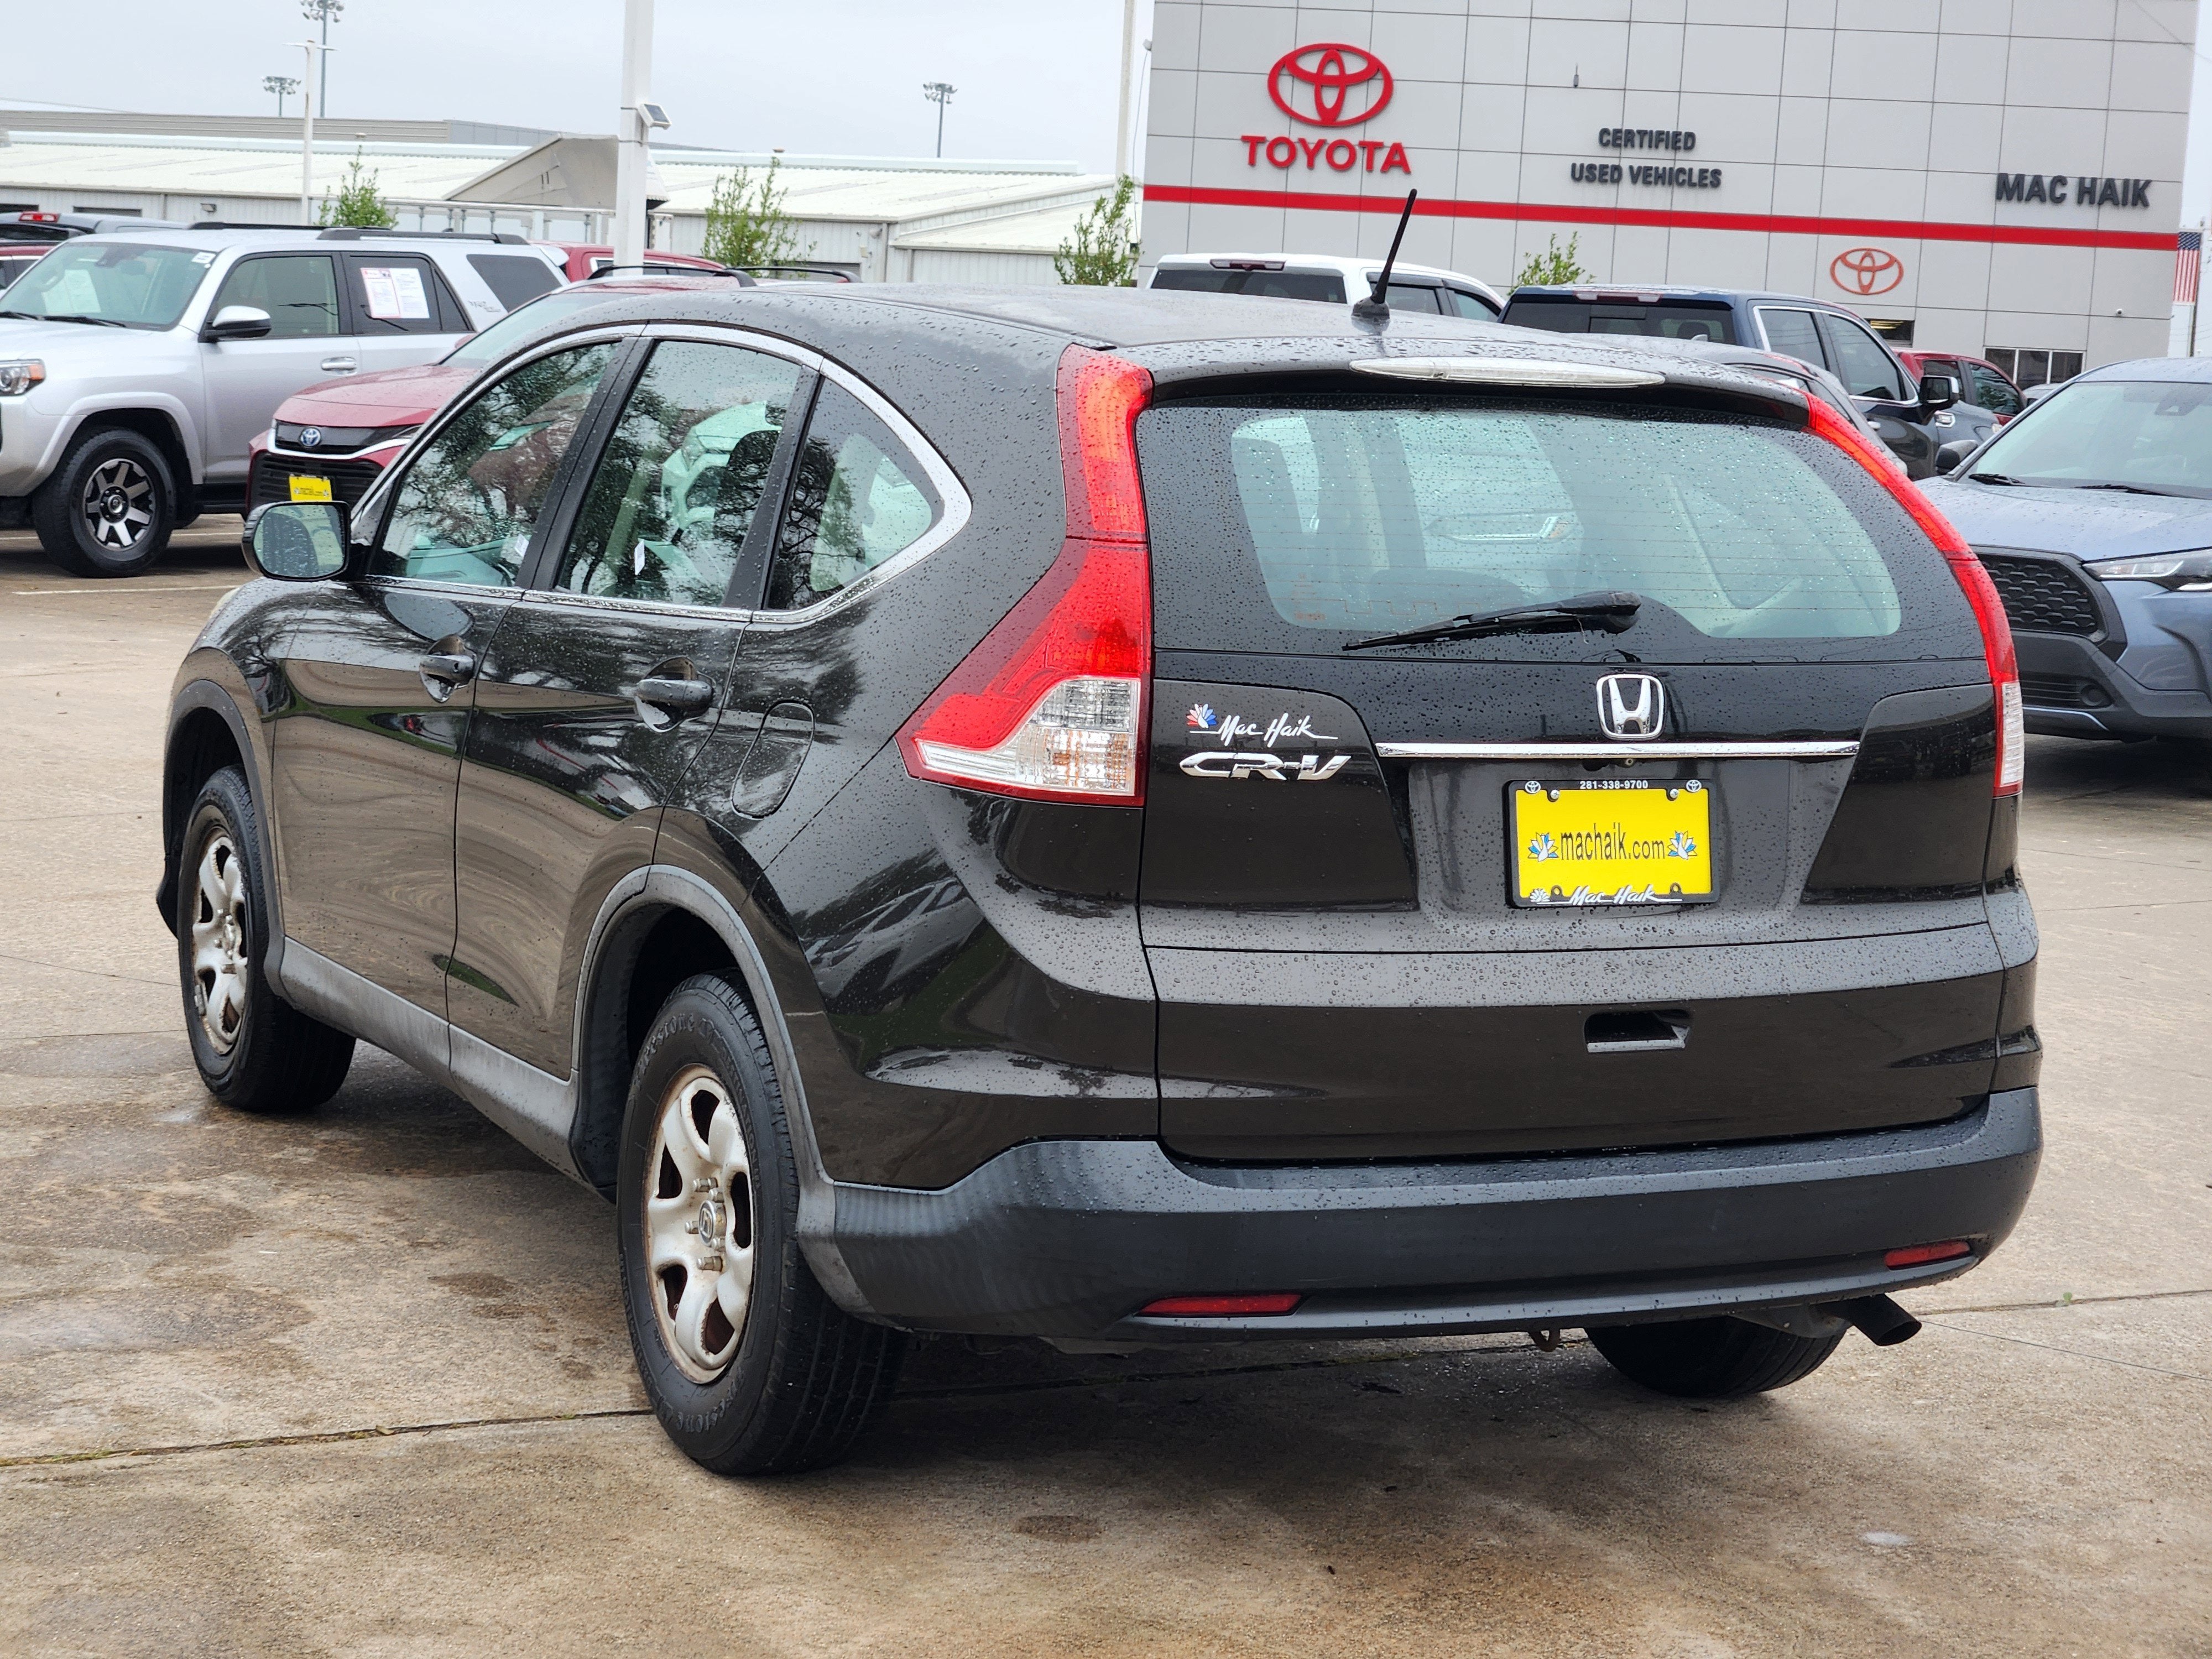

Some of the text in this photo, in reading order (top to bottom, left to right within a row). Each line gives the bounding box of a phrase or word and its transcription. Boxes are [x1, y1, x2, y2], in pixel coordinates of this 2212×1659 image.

[1241, 134, 1411, 174] TOYOTA
[1598, 127, 1696, 151] CERTIFIED
[1571, 162, 1723, 188] USED VEHICLES
[1996, 172, 2153, 208] MAC HAIK
[1197, 712, 1332, 748] Mac Haik
[1179, 751, 1352, 781] CR-V
[1579, 780, 1648, 790] 281-338-9700
[1560, 822, 1666, 860] machaik.com
[1551, 884, 1674, 906] Mac Haik
